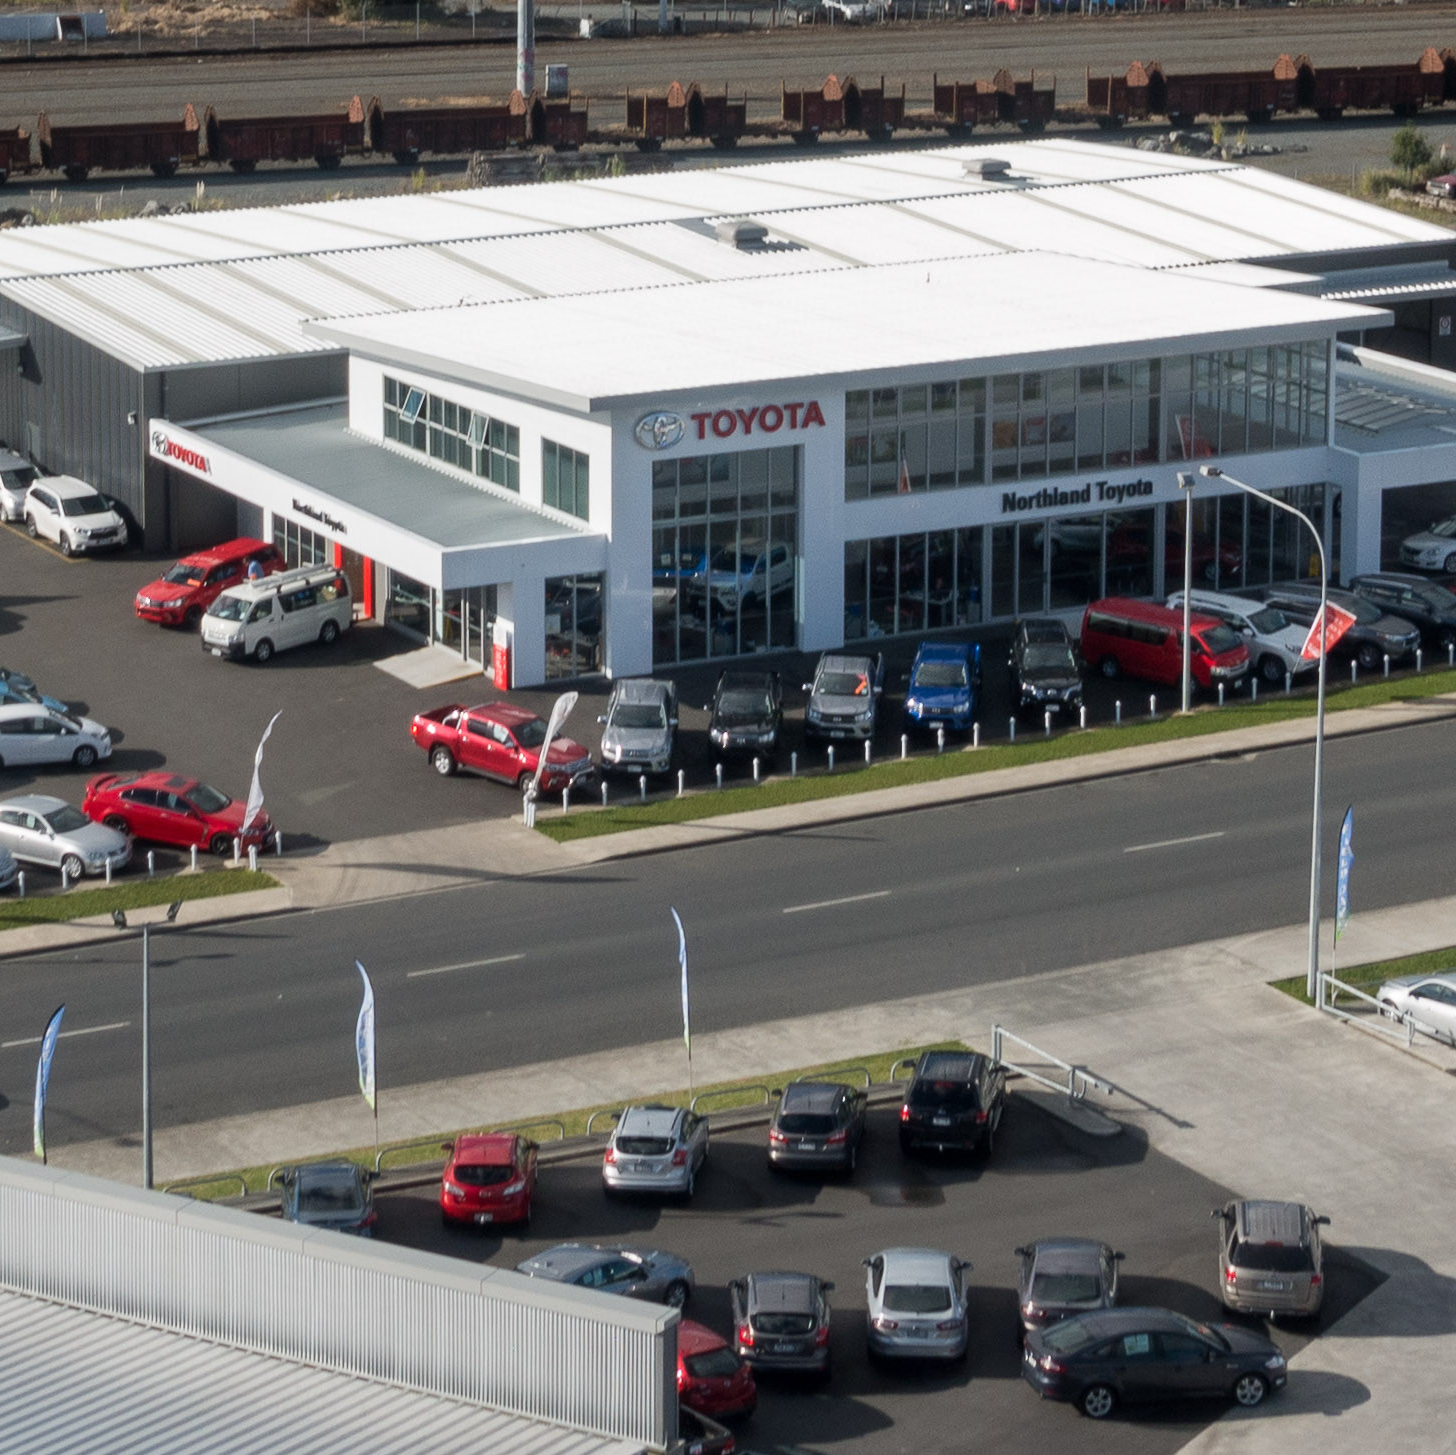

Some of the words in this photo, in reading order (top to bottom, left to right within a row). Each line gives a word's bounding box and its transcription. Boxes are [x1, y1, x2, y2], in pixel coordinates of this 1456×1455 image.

[691, 400, 826, 440] TOYOTA
[167, 440, 208, 473] TOYOTA
[1002, 483, 1091, 513] Northland
[1096, 478, 1154, 504] Toyota
